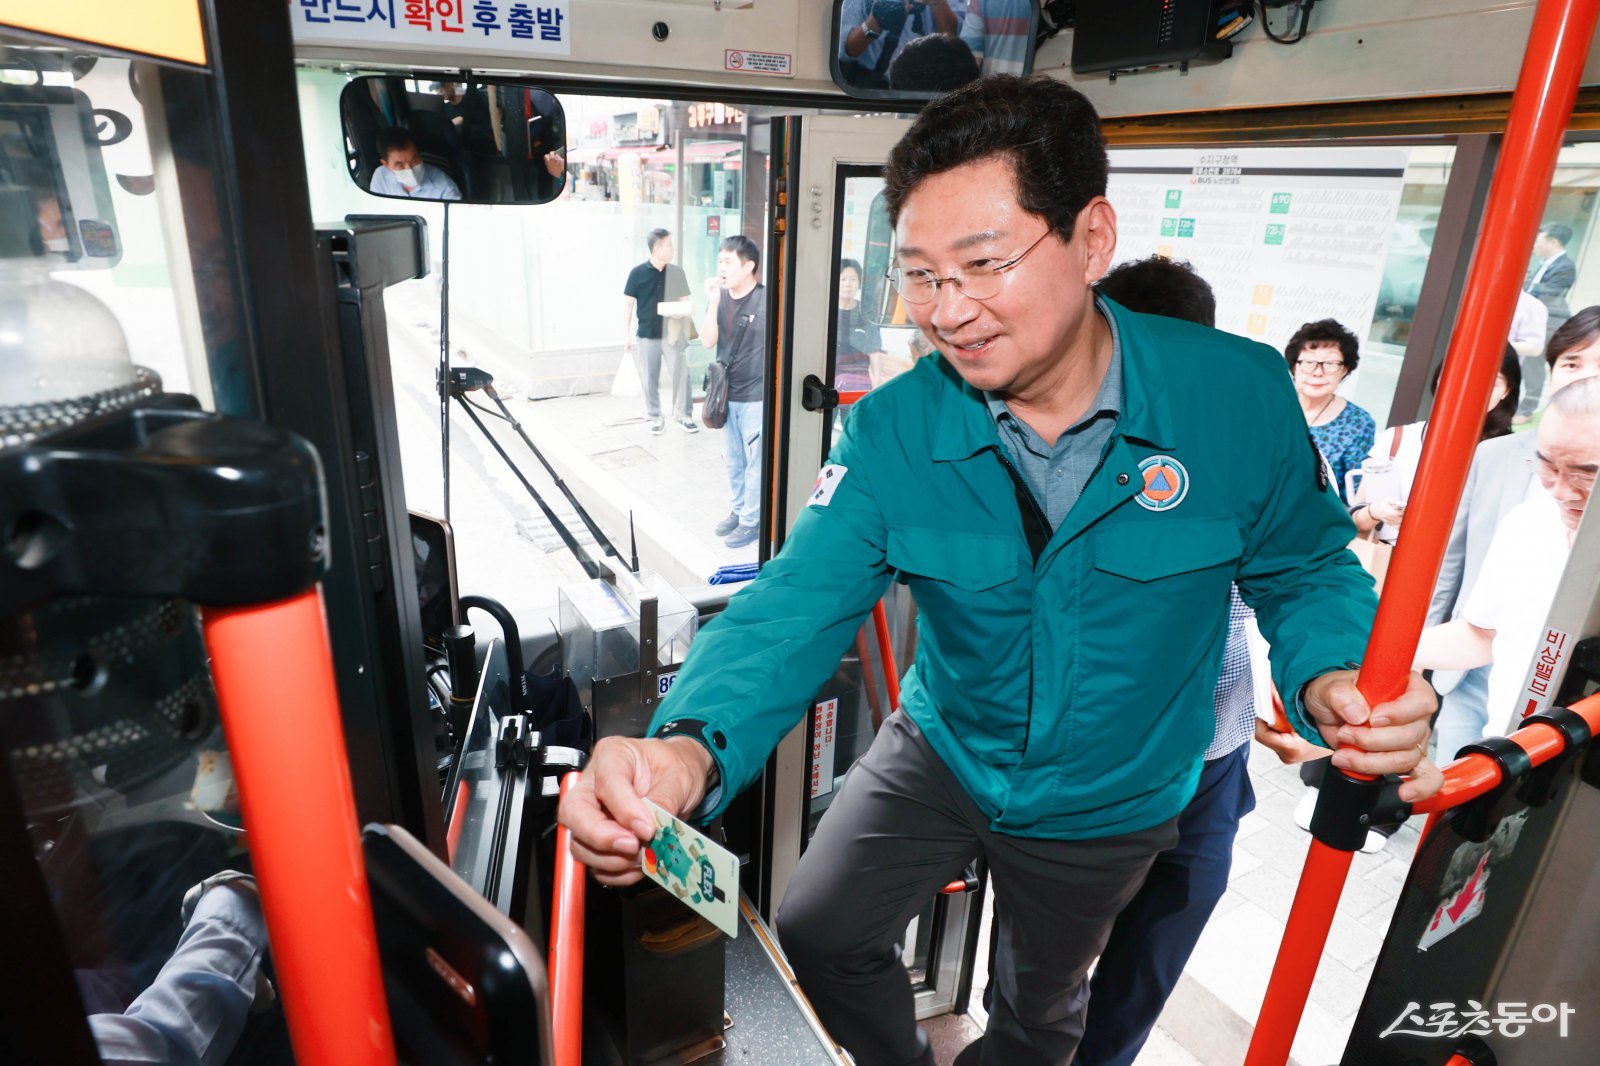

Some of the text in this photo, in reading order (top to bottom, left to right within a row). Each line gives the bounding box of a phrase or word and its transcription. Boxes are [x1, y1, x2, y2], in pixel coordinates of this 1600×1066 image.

[300, 0, 564, 42] 반드시 확인 후 출발
[1272, 194, 1290, 205] 690
[1527, 629, 1567, 697] 비상밸브
[703, 864, 714, 898] FLEX
